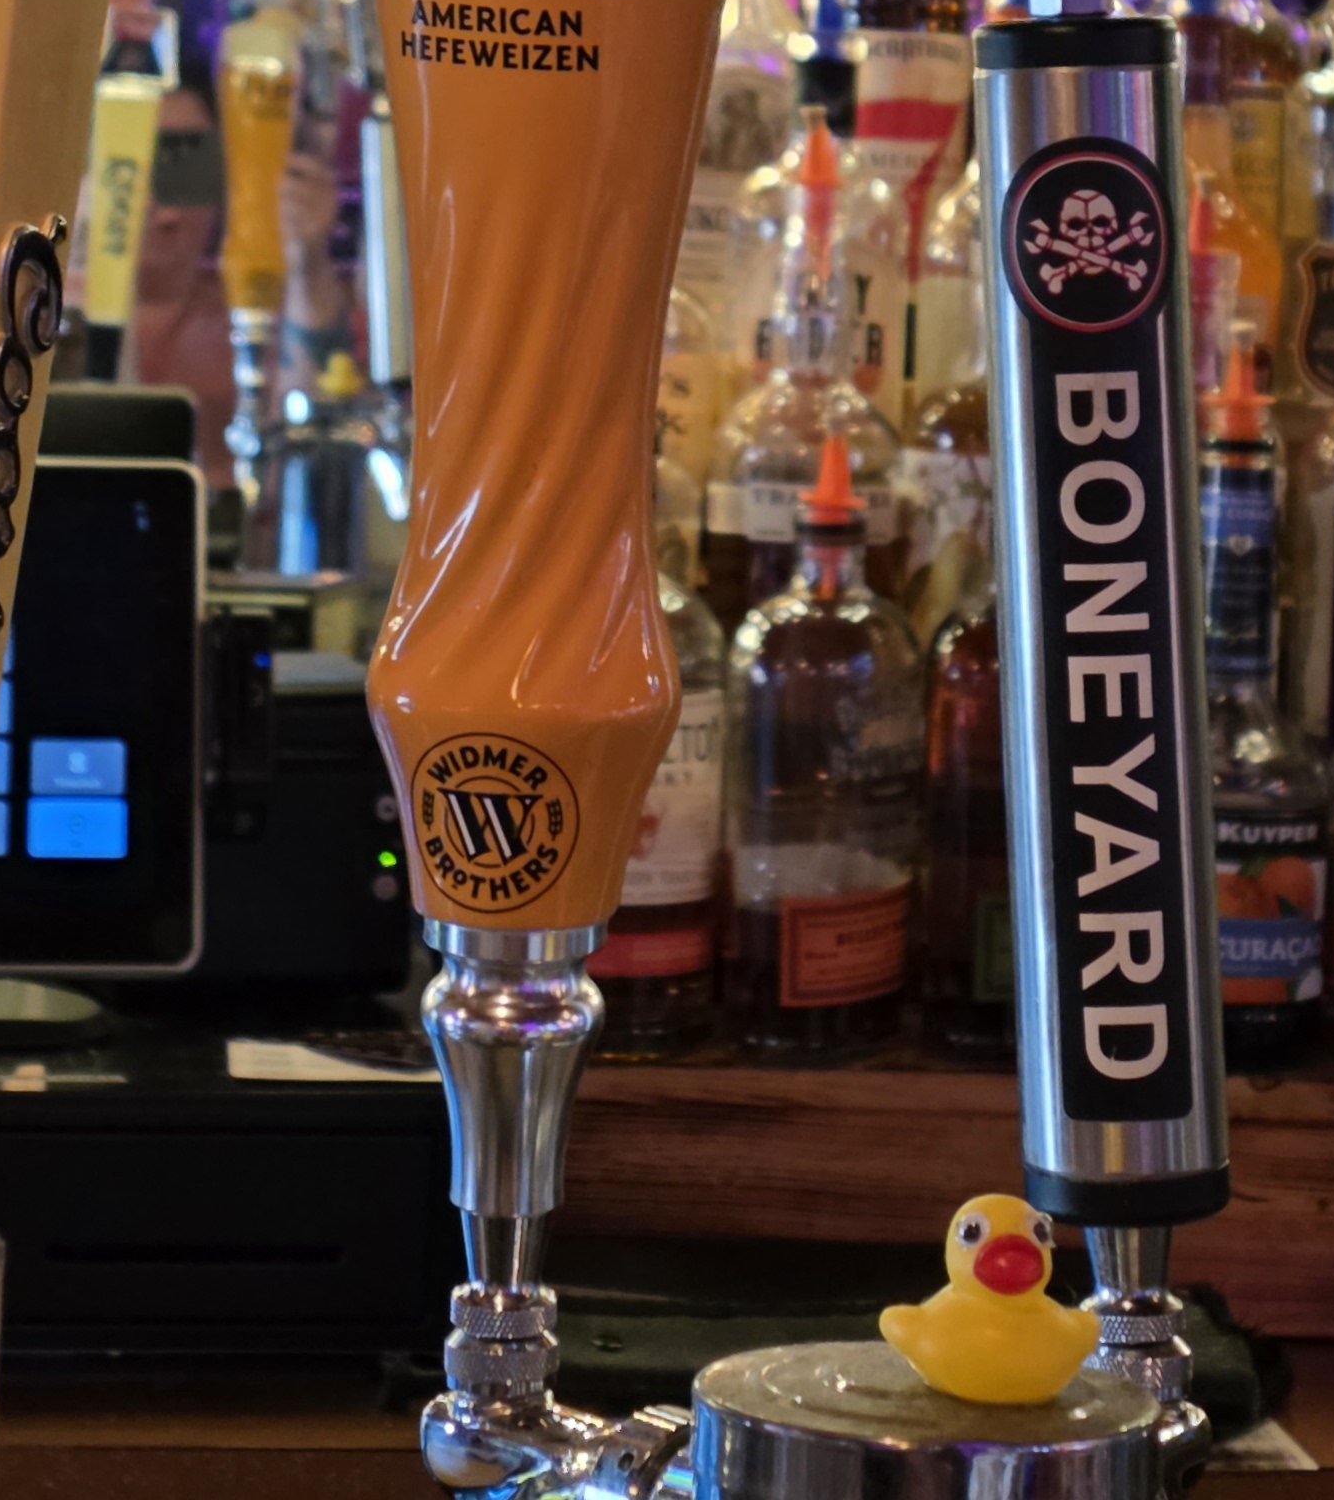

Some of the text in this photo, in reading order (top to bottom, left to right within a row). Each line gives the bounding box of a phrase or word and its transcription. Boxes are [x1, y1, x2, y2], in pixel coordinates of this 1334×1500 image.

[400, 30, 600, 72] HEFEWEIZEN
[1054, 369, 1169, 1081] BONEYARD
[426, 744, 549, 791] WIDMER
[437, 786, 543, 867] W
[424, 835, 560, 902] BROTHERS
